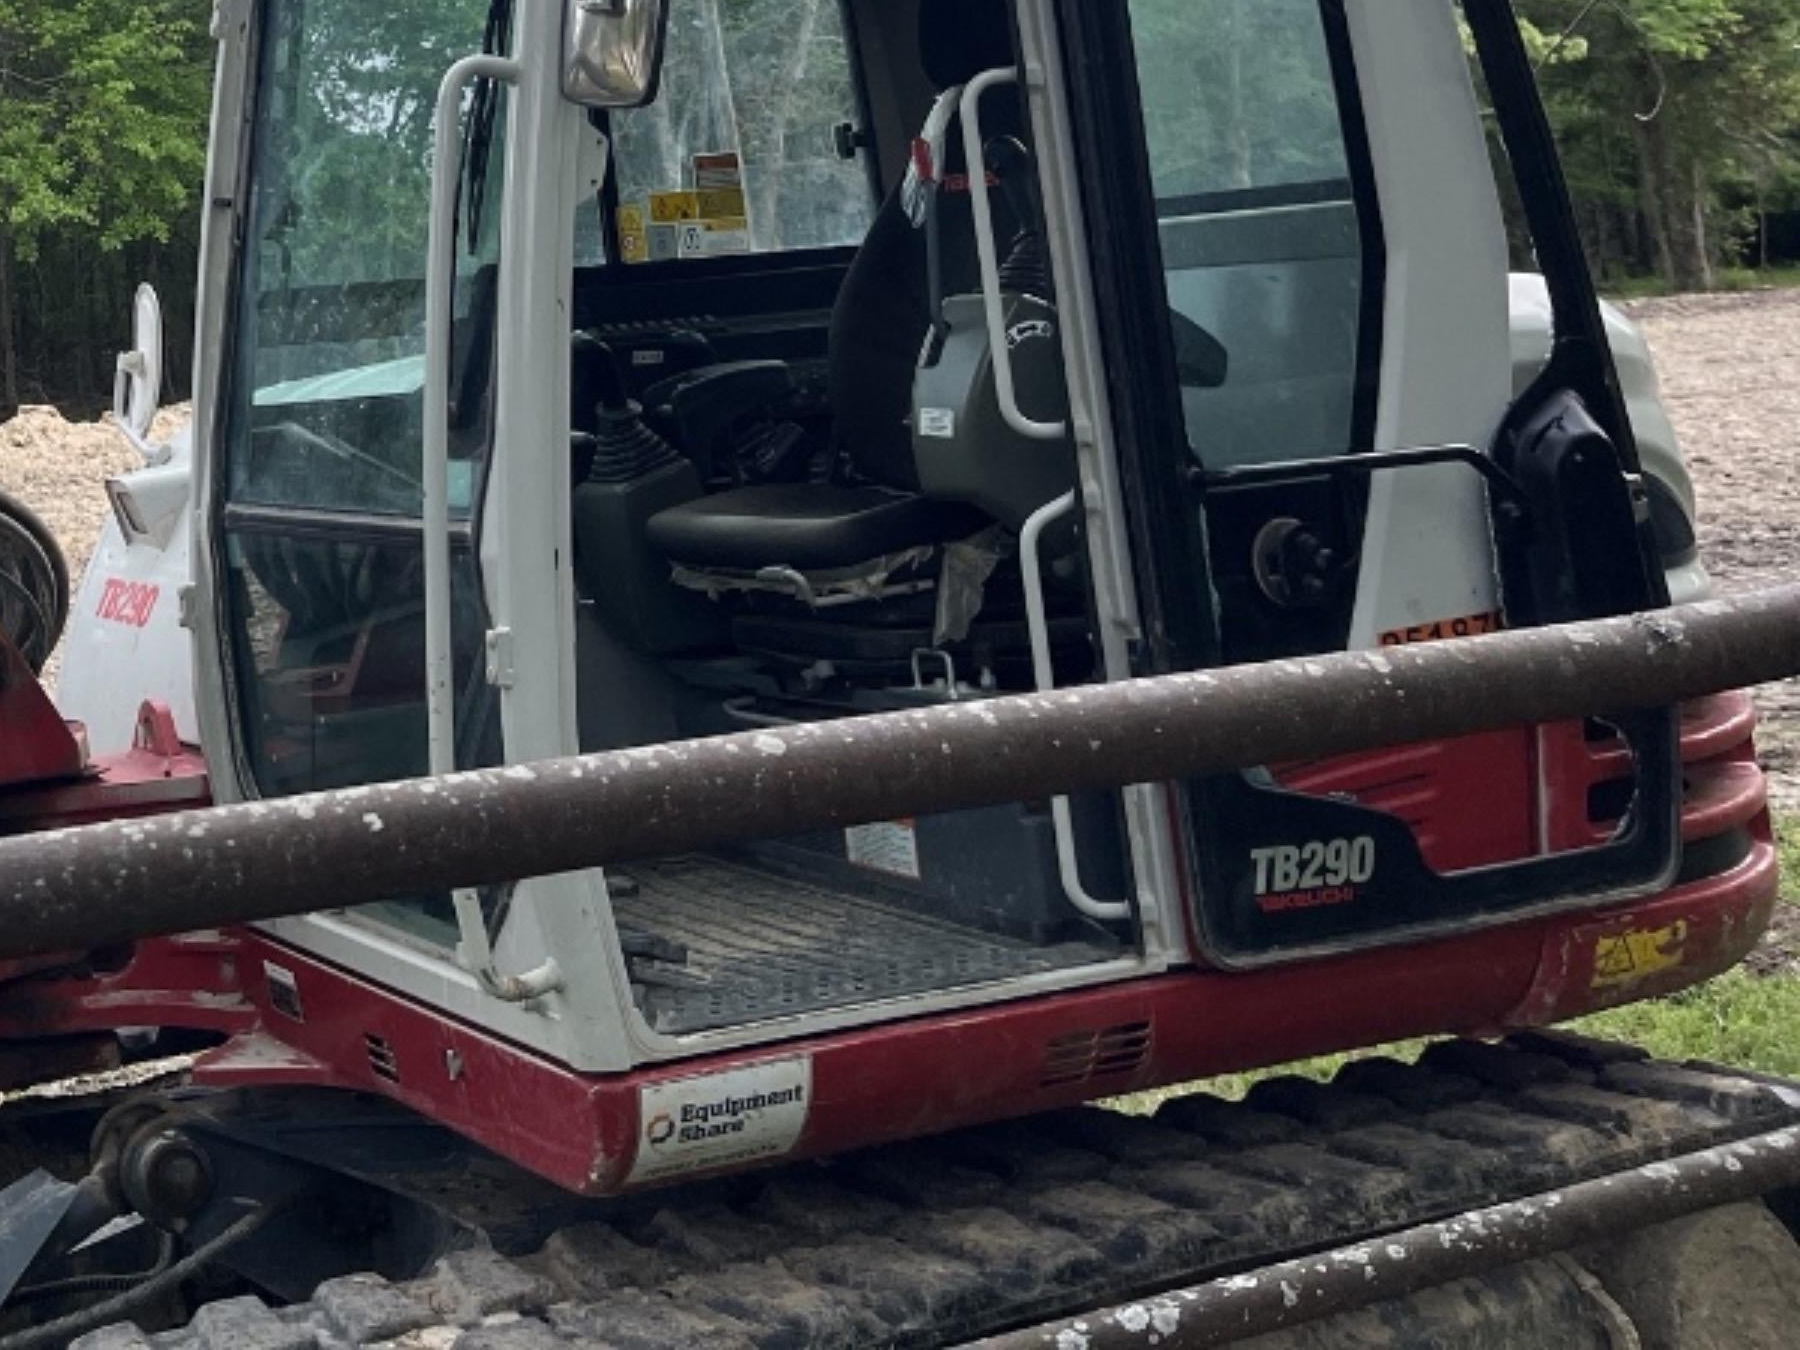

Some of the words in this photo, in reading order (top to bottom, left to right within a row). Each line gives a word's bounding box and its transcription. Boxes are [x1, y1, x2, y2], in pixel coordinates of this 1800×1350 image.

[1251, 836, 1375, 895] TB290
[680, 1084, 804, 1122] Equipment
[678, 1118, 745, 1142] Share
